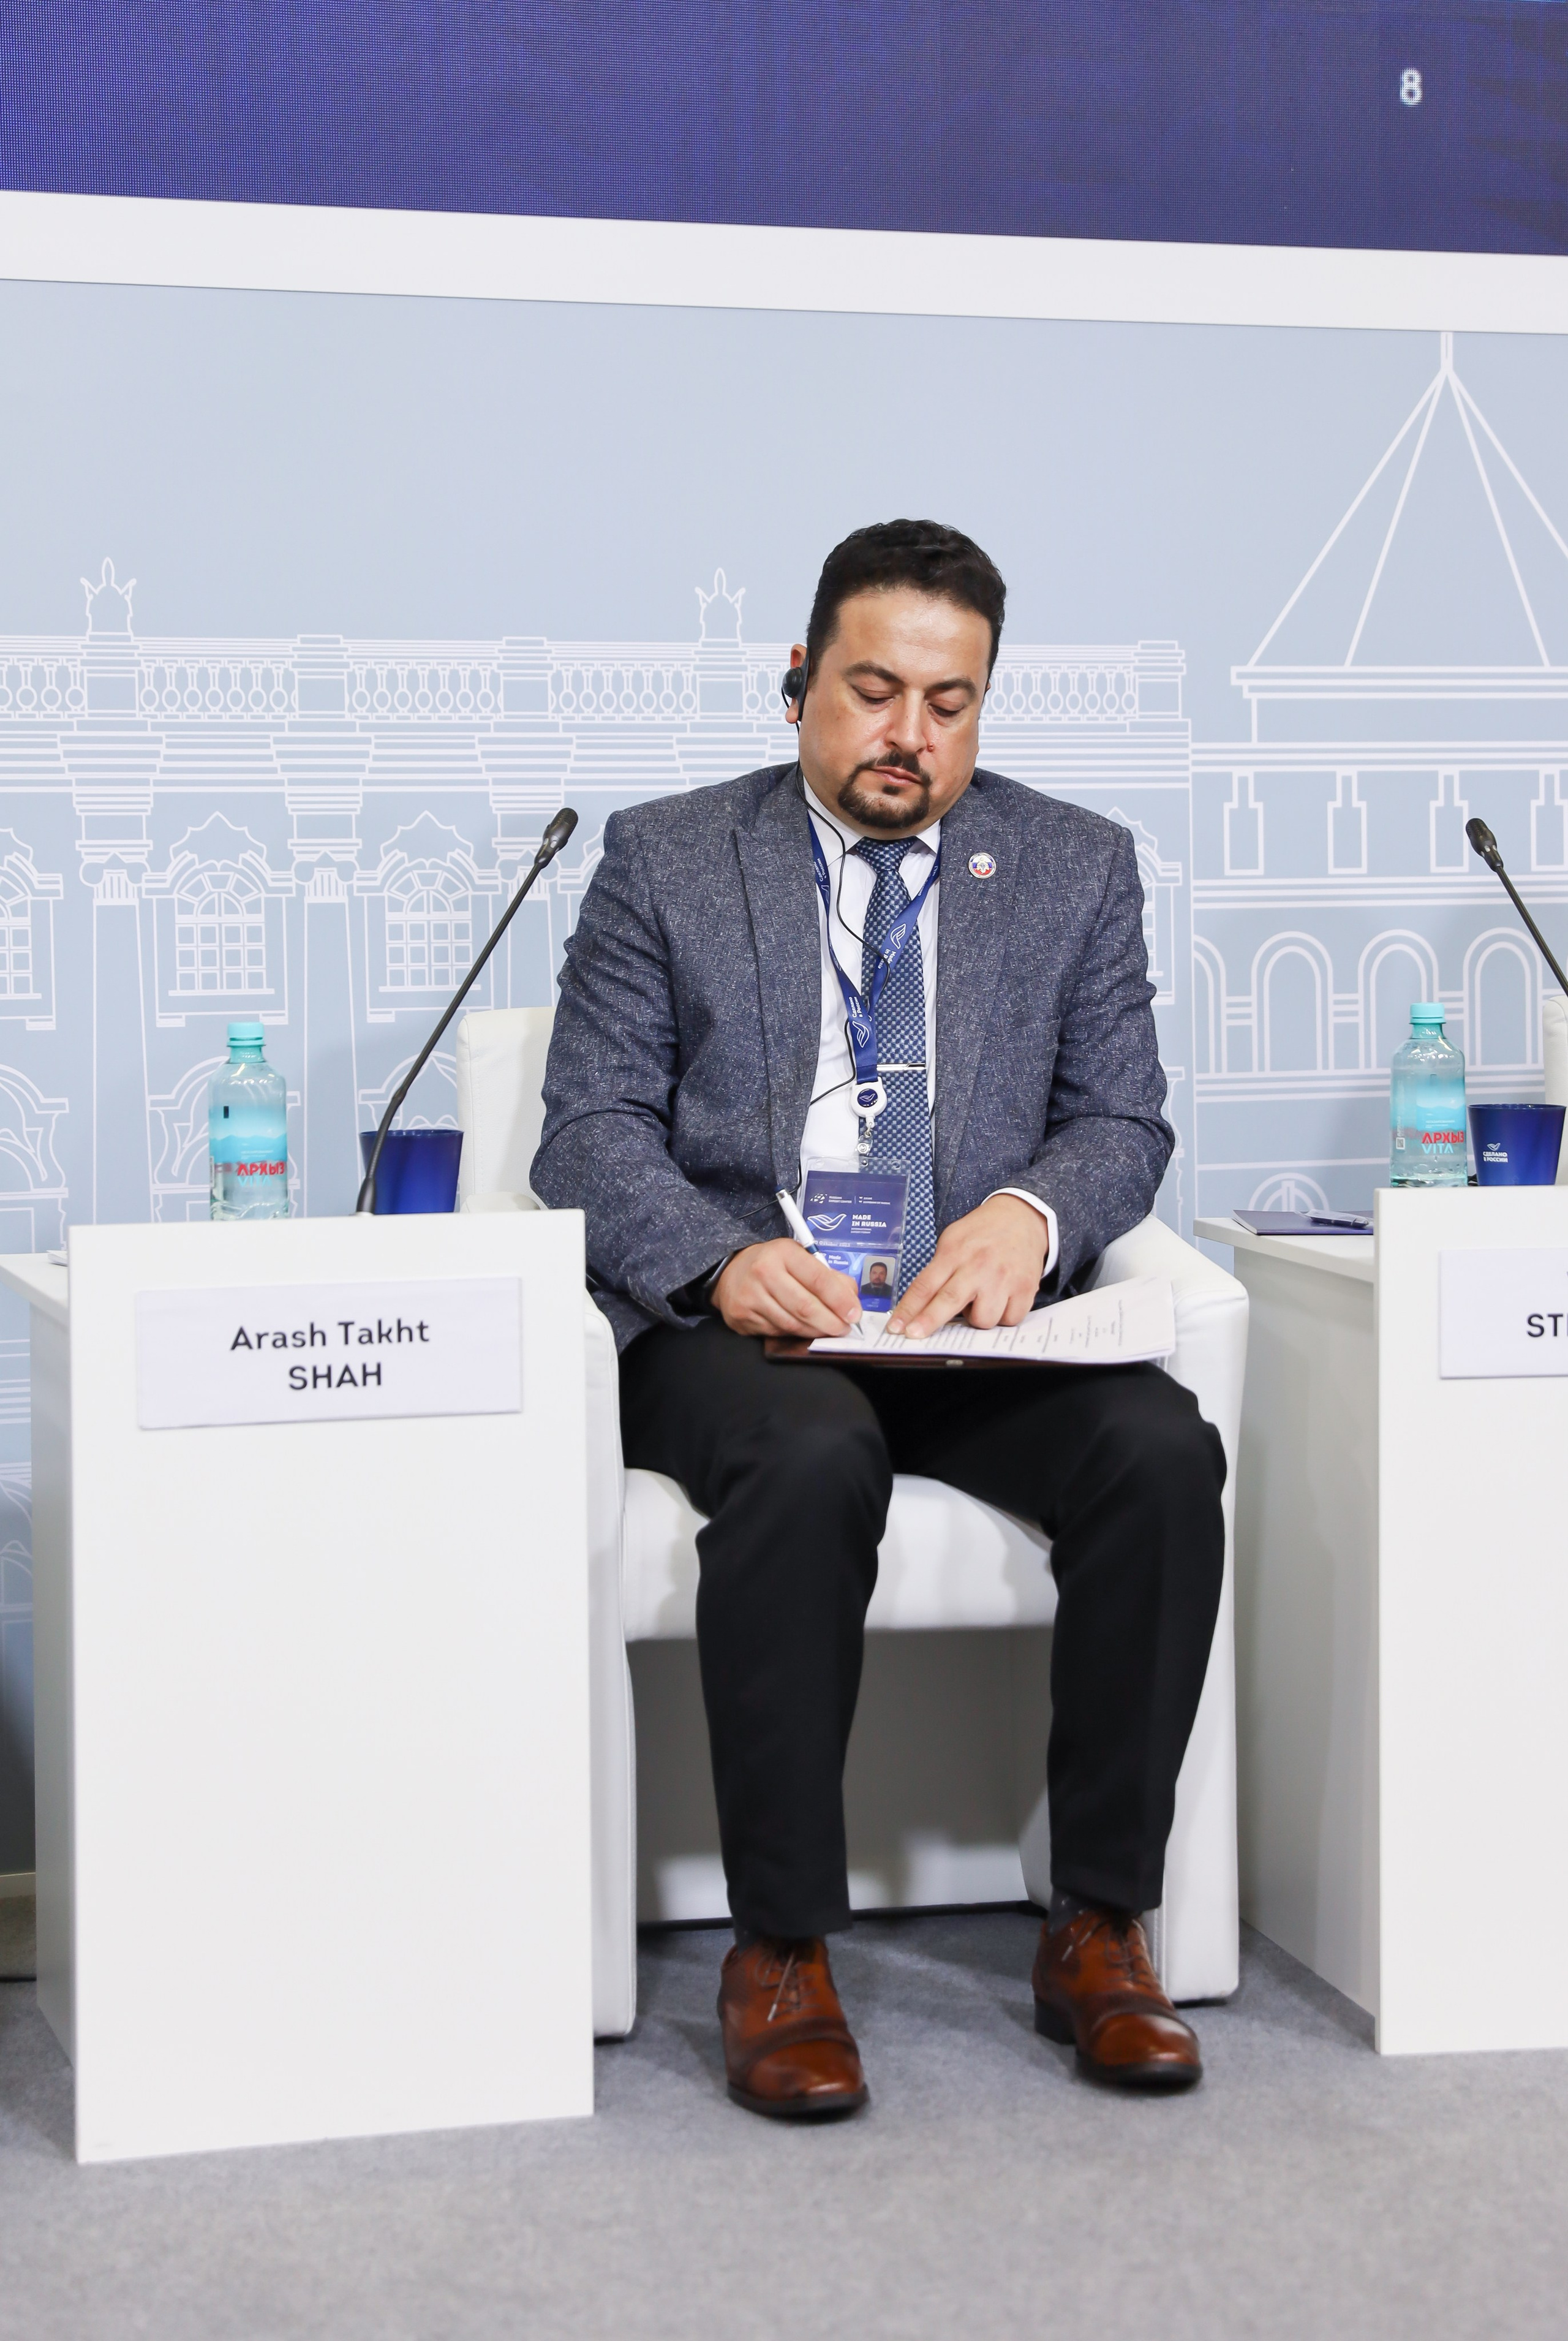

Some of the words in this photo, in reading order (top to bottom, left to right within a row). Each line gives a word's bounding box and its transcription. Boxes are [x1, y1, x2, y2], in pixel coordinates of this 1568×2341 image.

[1400, 68, 1423, 106] 8
[877, 954, 888, 969] Rssia
[887, 951, 897, 964] Made
[848, 996, 858, 1018] Сделано
[853, 996, 862, 1014] России
[1421, 1143, 1454, 1154] VITA
[237, 1176, 273, 1187] VITA
[229, 1322, 327, 1351] Arash
[337, 1318, 430, 1345] Takht
[1527, 1313, 1568, 1337] ST
[288, 1361, 382, 1390] SHAH
